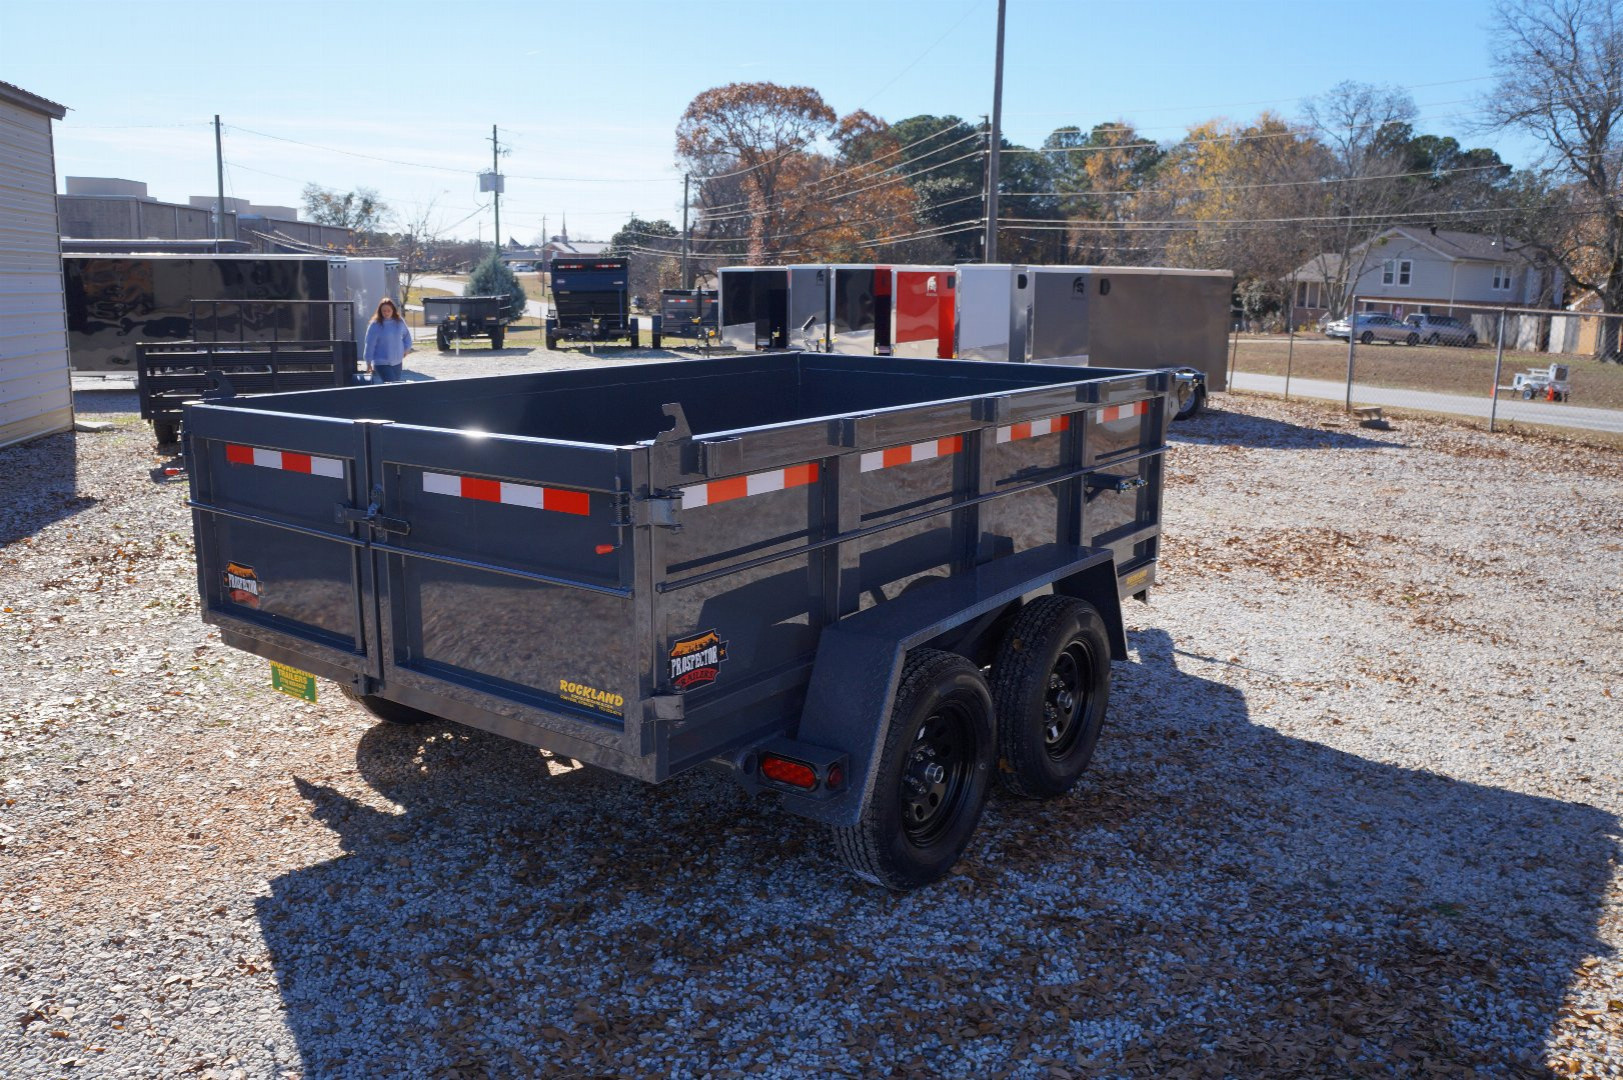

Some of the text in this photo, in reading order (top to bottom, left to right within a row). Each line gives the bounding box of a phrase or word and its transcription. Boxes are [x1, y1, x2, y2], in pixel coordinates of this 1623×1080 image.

[227, 573, 258, 595] PROSPECTOR
[671, 645, 718, 678] PROSPECTOR
[278, 668, 307, 684] TRAILERS
[559, 679, 624, 707] ROCKLAND
